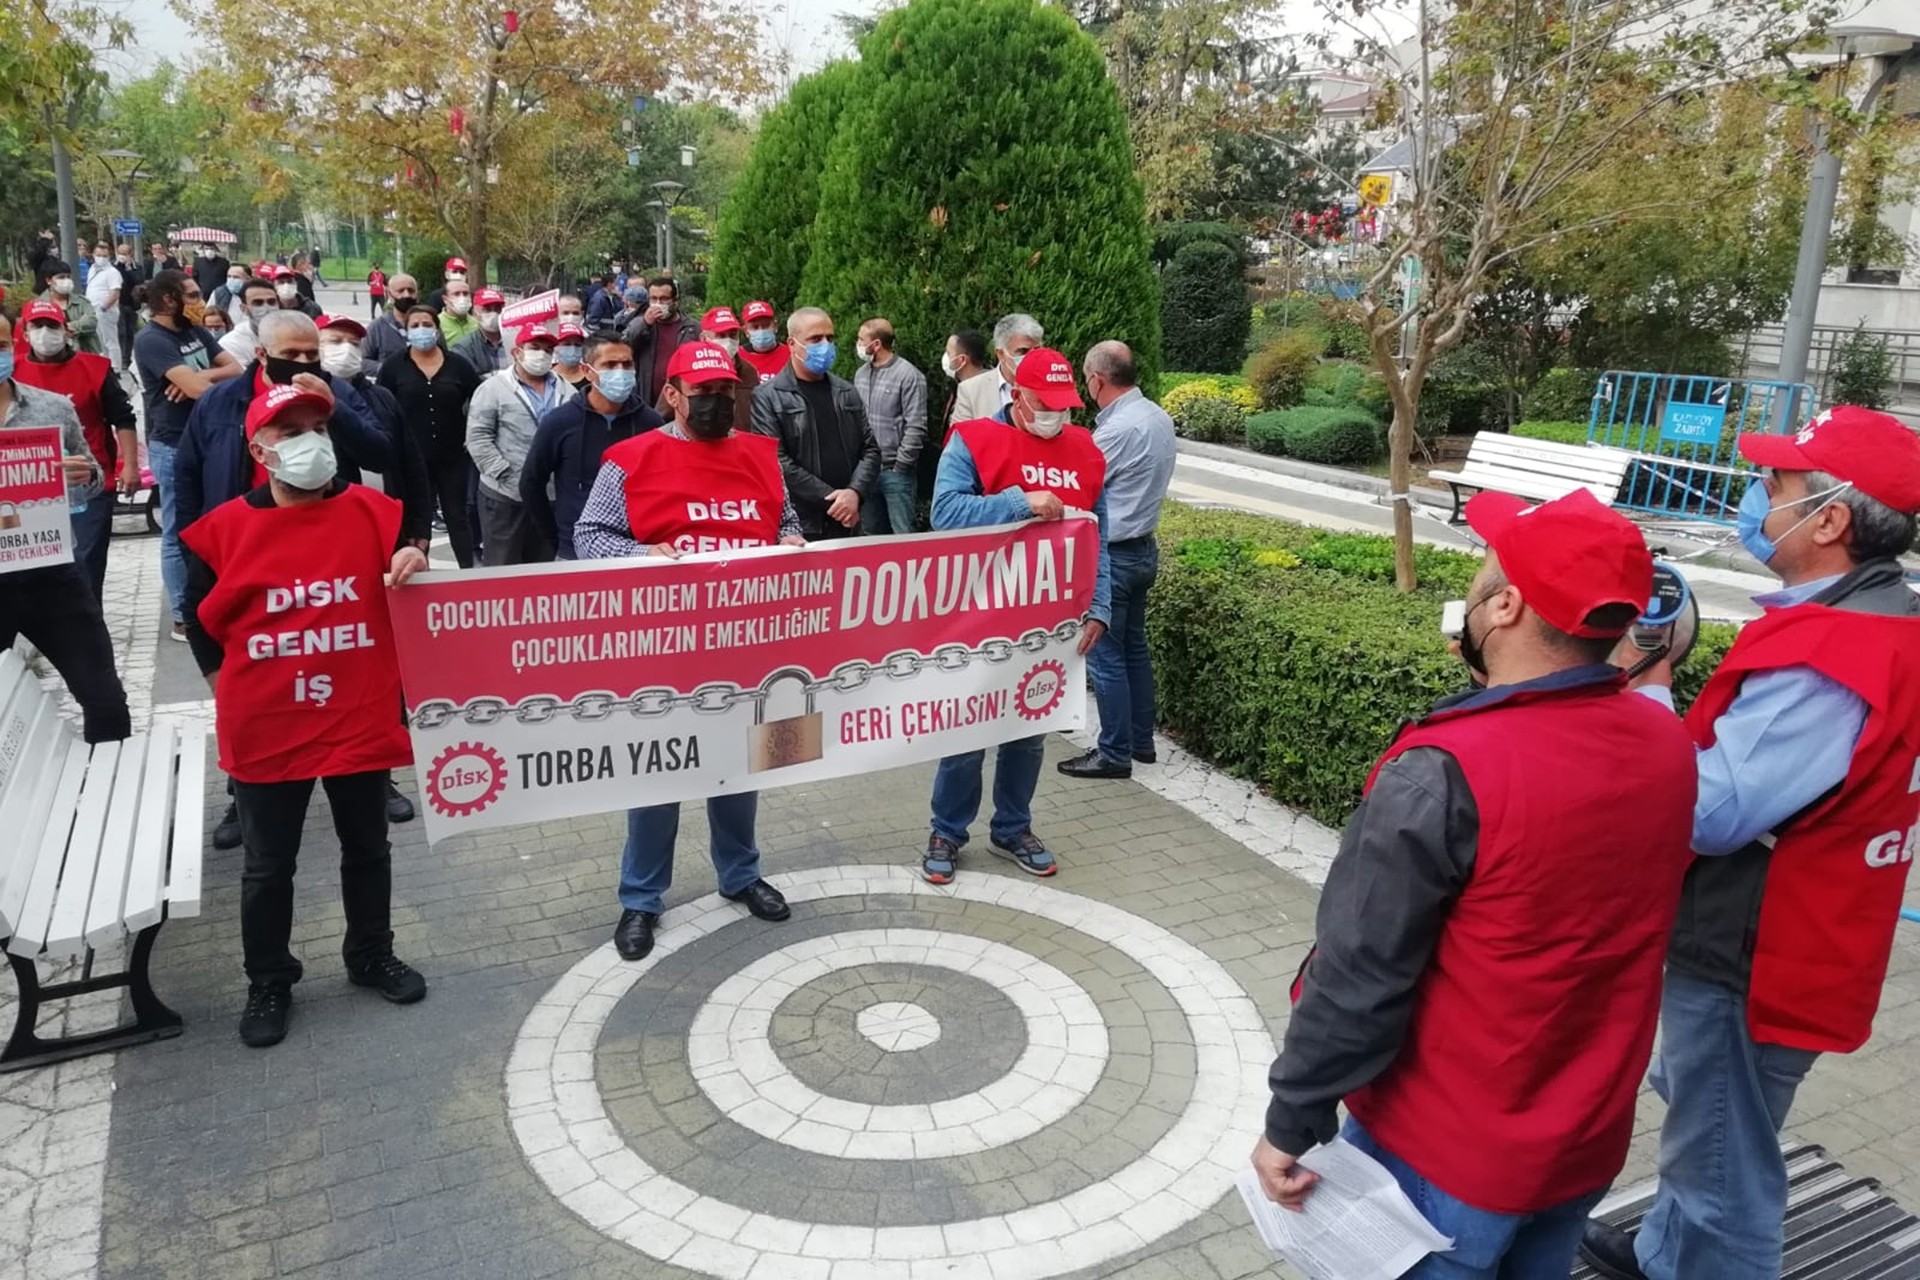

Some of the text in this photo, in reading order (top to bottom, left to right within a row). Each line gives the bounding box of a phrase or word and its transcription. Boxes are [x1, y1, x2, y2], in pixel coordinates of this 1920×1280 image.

[1021, 462, 1081, 490] DİSK
[686, 497, 762, 521] DİSK
[32, 529, 61, 544] YASA
[266, 576, 359, 613] DİSK
[839, 536, 1076, 631] DOKUNMA!
[426, 568, 834, 638] ÇOCUKLARIMIZIN KIDEM TAZMİNATINA
[247, 622, 375, 660] GENEL
[511, 606, 832, 674] ÇOCUKLARIMIZIN EMEKLİLİĞİNE
[294, 669, 333, 707] İŞ
[1026, 681, 1056, 699] DİSK
[839, 689, 1008, 745] GERİ ÇEKİLSİN!
[441, 768, 490, 791] DİSK
[517, 735, 701, 790] TORBA YASA
